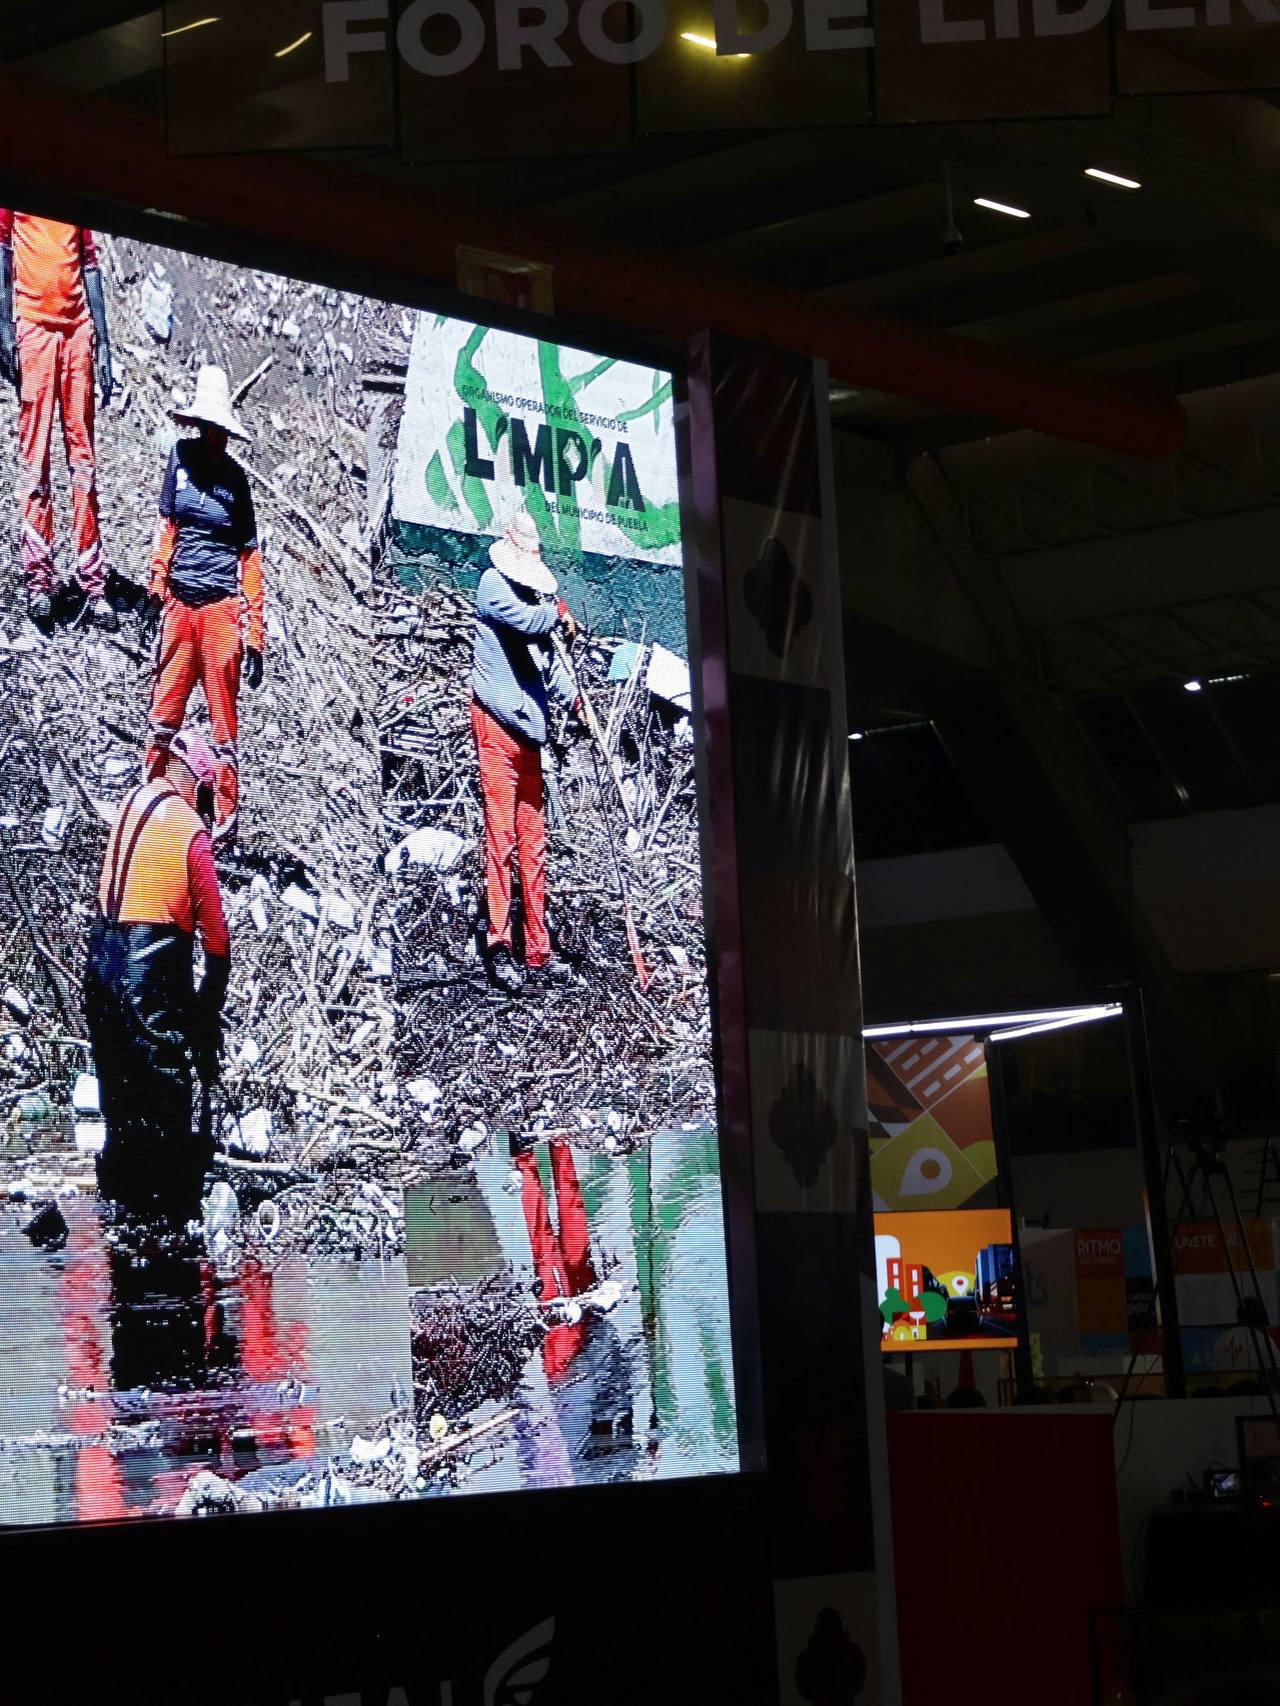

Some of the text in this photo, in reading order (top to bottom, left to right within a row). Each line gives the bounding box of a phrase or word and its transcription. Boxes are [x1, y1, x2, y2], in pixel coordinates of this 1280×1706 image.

[322, 0, 667, 83] FORO
[714, 0, 876, 56] DE
[579, 412, 618, 431] SERVICIO
[1075, 1237, 1122, 1257] RITMO
